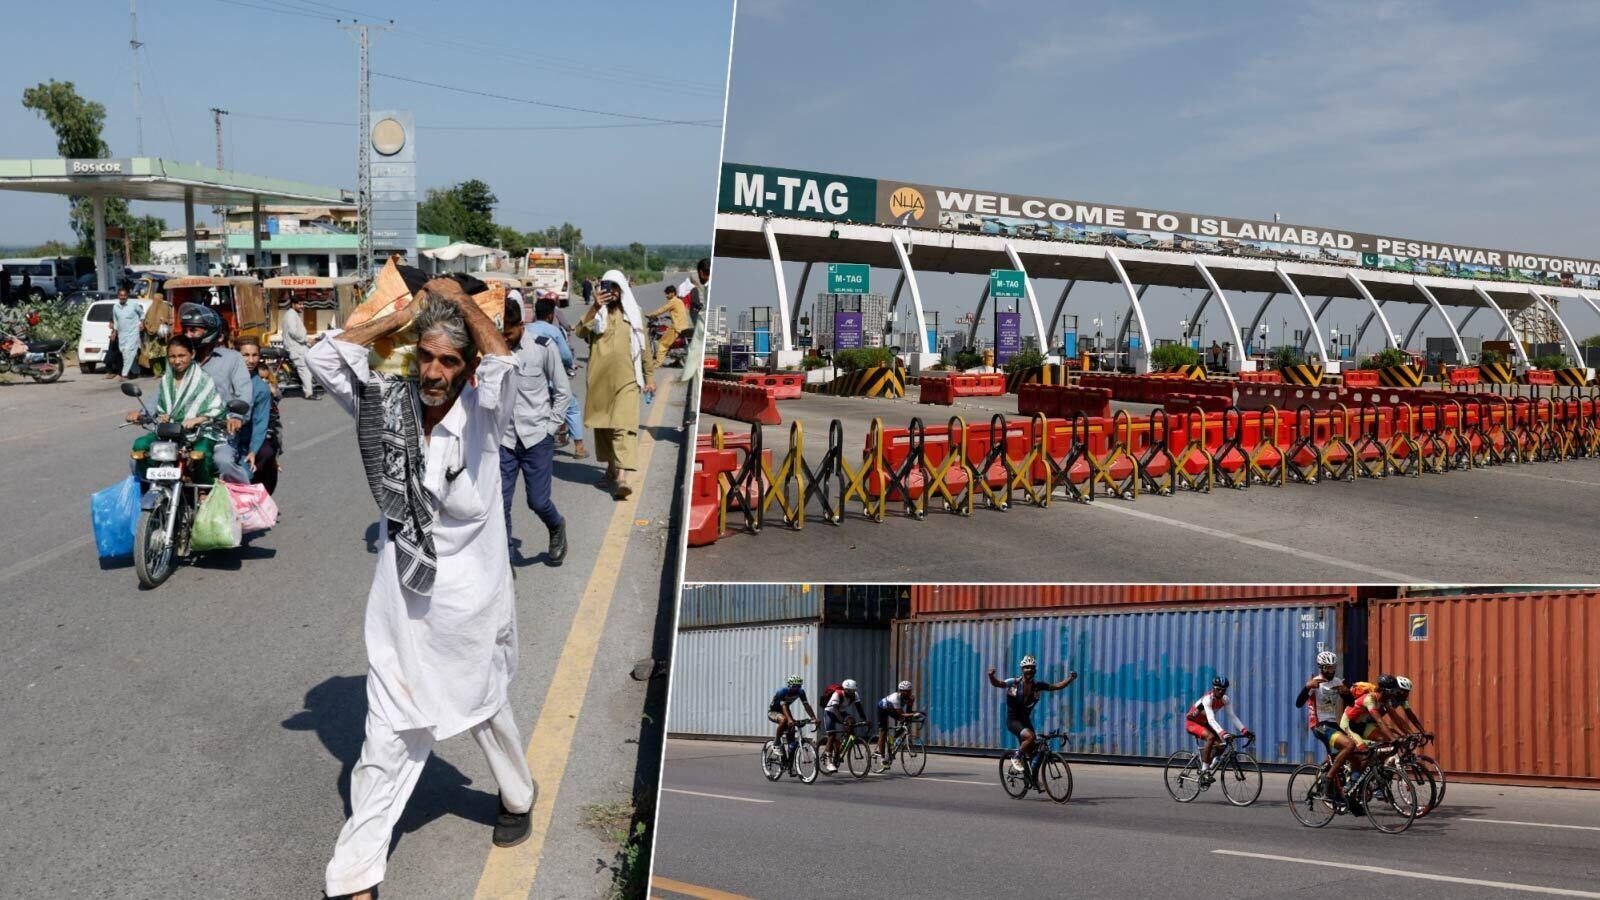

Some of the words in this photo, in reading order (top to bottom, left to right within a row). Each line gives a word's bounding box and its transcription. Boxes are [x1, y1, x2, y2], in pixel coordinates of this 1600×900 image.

[734, 171, 848, 216] M-TAG
[892, 192, 925, 210] NHA
[936, 190, 1126, 227] WELCOME
[1136, 211, 1180, 232] TO
[1190, 217, 1354, 249] ISLAMABAD
[1376, 238, 1501, 266] PESHAWAR
[835, 274, 863, 283] M-TAG
[996, 280, 1019, 289] M-TAG
